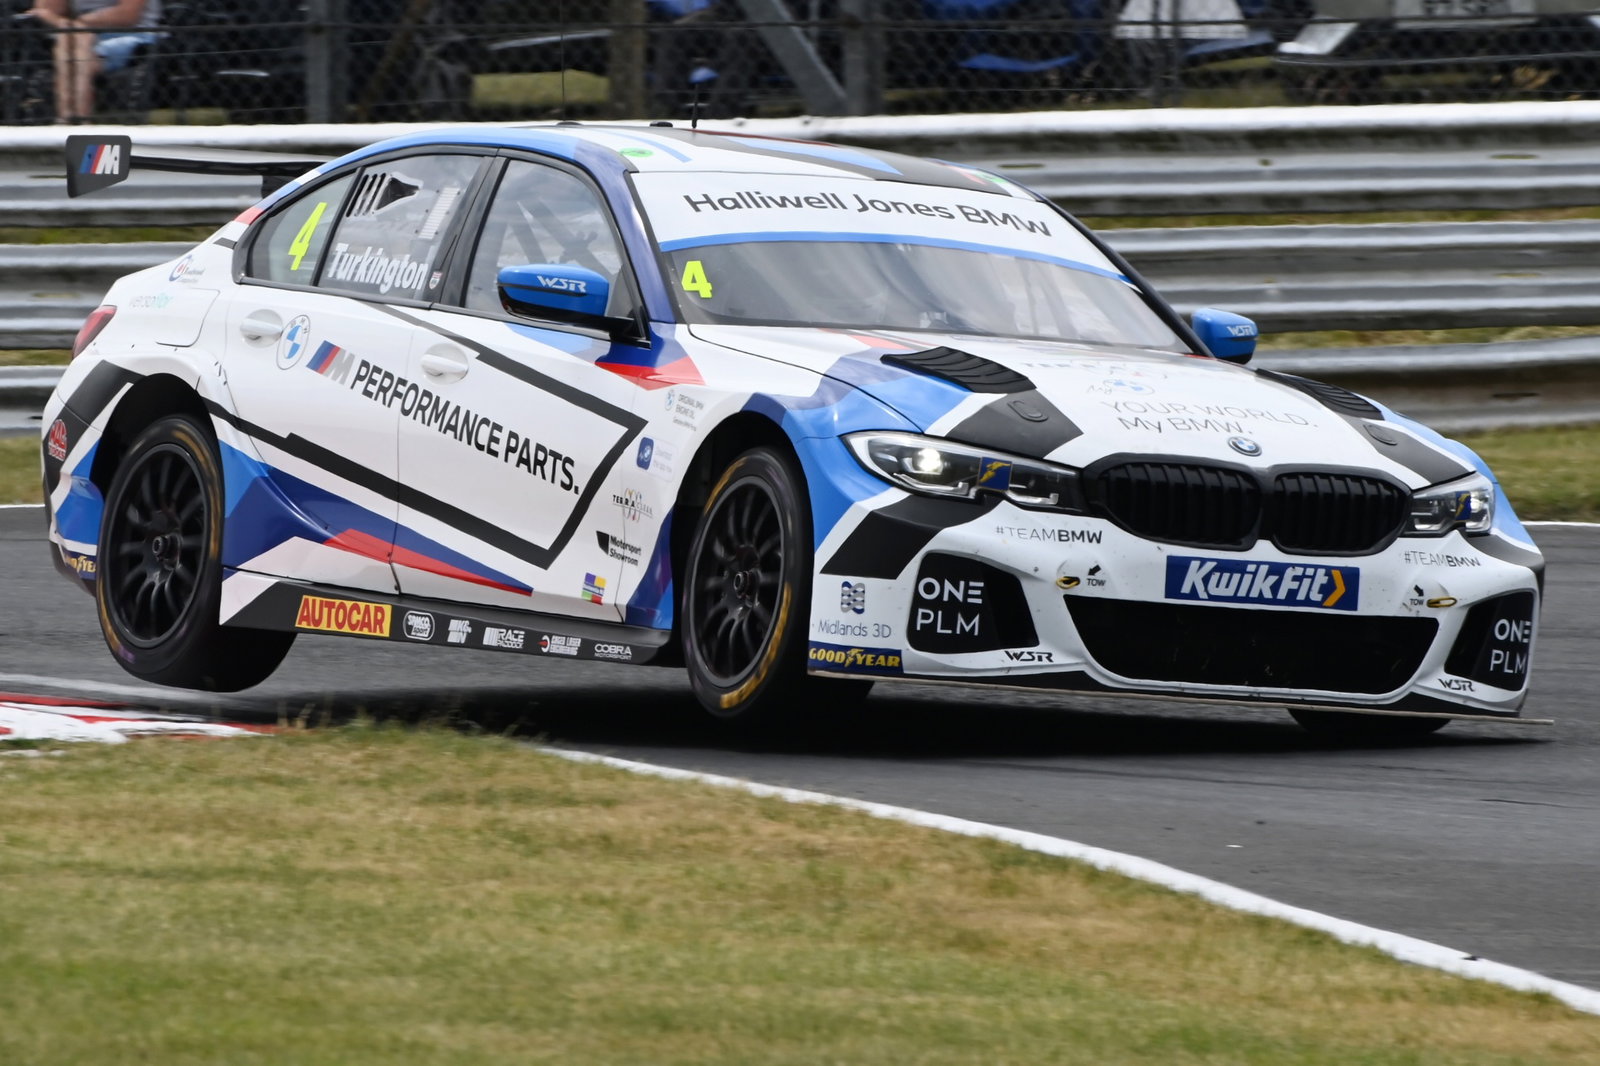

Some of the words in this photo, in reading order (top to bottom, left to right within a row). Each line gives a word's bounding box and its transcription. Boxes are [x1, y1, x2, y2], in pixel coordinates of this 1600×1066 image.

[683, 190, 849, 213] Halliwell
[855, 193, 955, 220] Jones
[955, 204, 1053, 237] BMW
[288, 202, 328, 270] 4
[328, 243, 429, 294] Turkington
[536, 275, 587, 293] WSR
[681, 260, 712, 298] 4
[1226, 325, 1255, 337] WSR
[1101, 401, 1193, 415] YOUR
[1195, 404, 1318, 427] WORLD.
[350, 360, 503, 458] PERFORMANCE
[504, 430, 580, 495] PARTS.
[1117, 416, 1162, 434] My
[1167, 417, 1253, 434] BMW.
[995, 525, 1102, 544] #TEAMBMW
[610, 535, 641, 555] Motorsport
[609, 547, 638, 566] Showroom
[1404, 550, 1481, 567] #TEAMBMW
[917, 577, 984, 604] ONE
[1086, 578, 1106, 587] TOW
[1410, 598, 1424, 606] TOW
[297, 597, 385, 634] AUTOCAR
[916, 608, 980, 636] PLM
[497, 628, 525, 642] RACE
[817, 619, 868, 638] Midlands
[873, 623, 892, 638] 3D
[1494, 618, 1532, 643] ONE
[594, 643, 632, 656] COBRA
[1003, 650, 1054, 663] WSR
[1489, 649, 1527, 674] PLM
[1438, 678, 1475, 692] WSR
